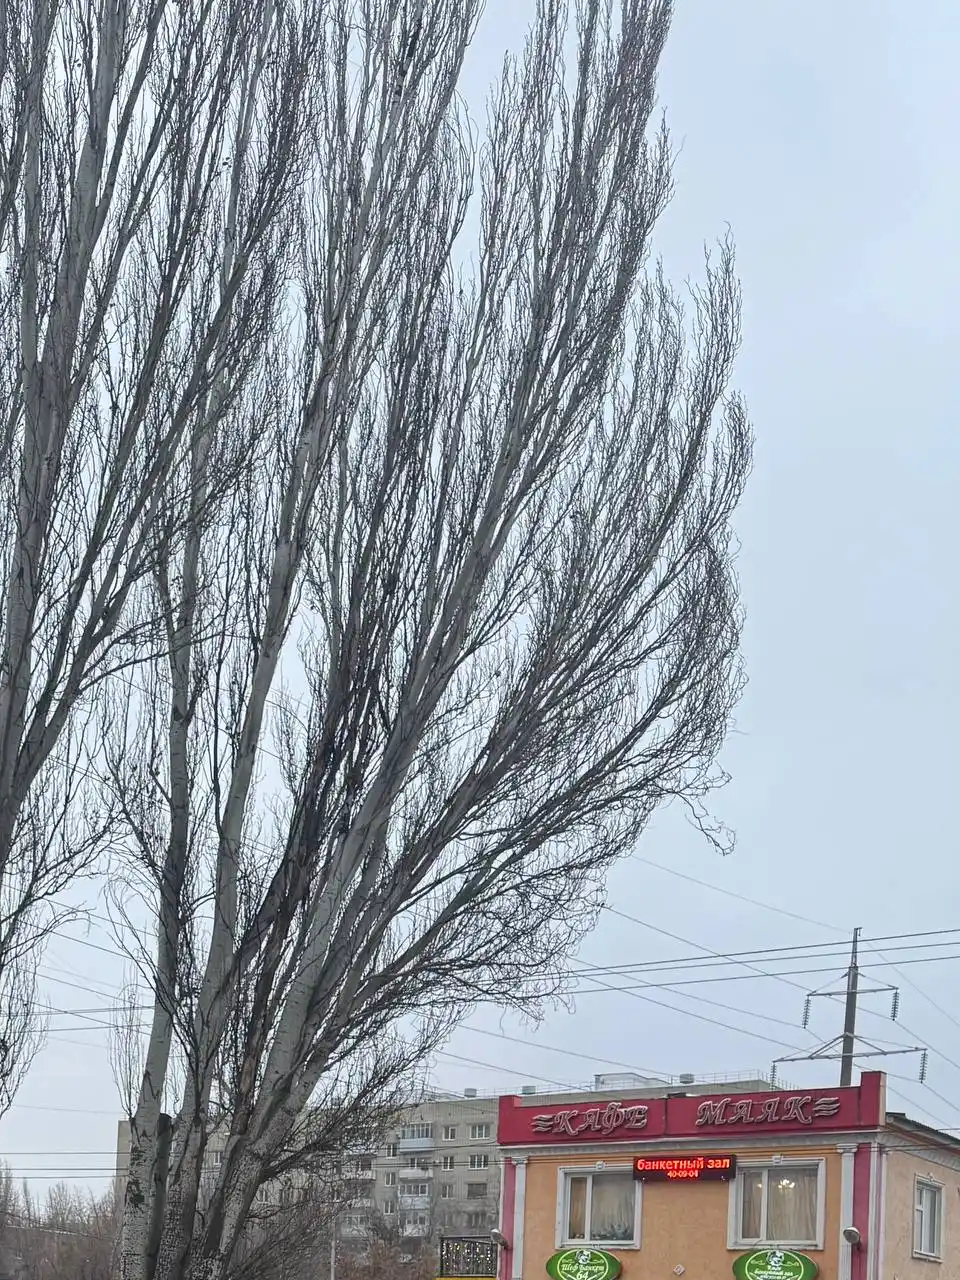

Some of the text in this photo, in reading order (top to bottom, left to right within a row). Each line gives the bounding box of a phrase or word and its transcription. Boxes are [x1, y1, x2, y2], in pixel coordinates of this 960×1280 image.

[552, 1095, 813, 1136] КАФЕ МАЯК
[637, 1157, 730, 1170] банкетный зал
[576, 1271, 589, 1280] 64
